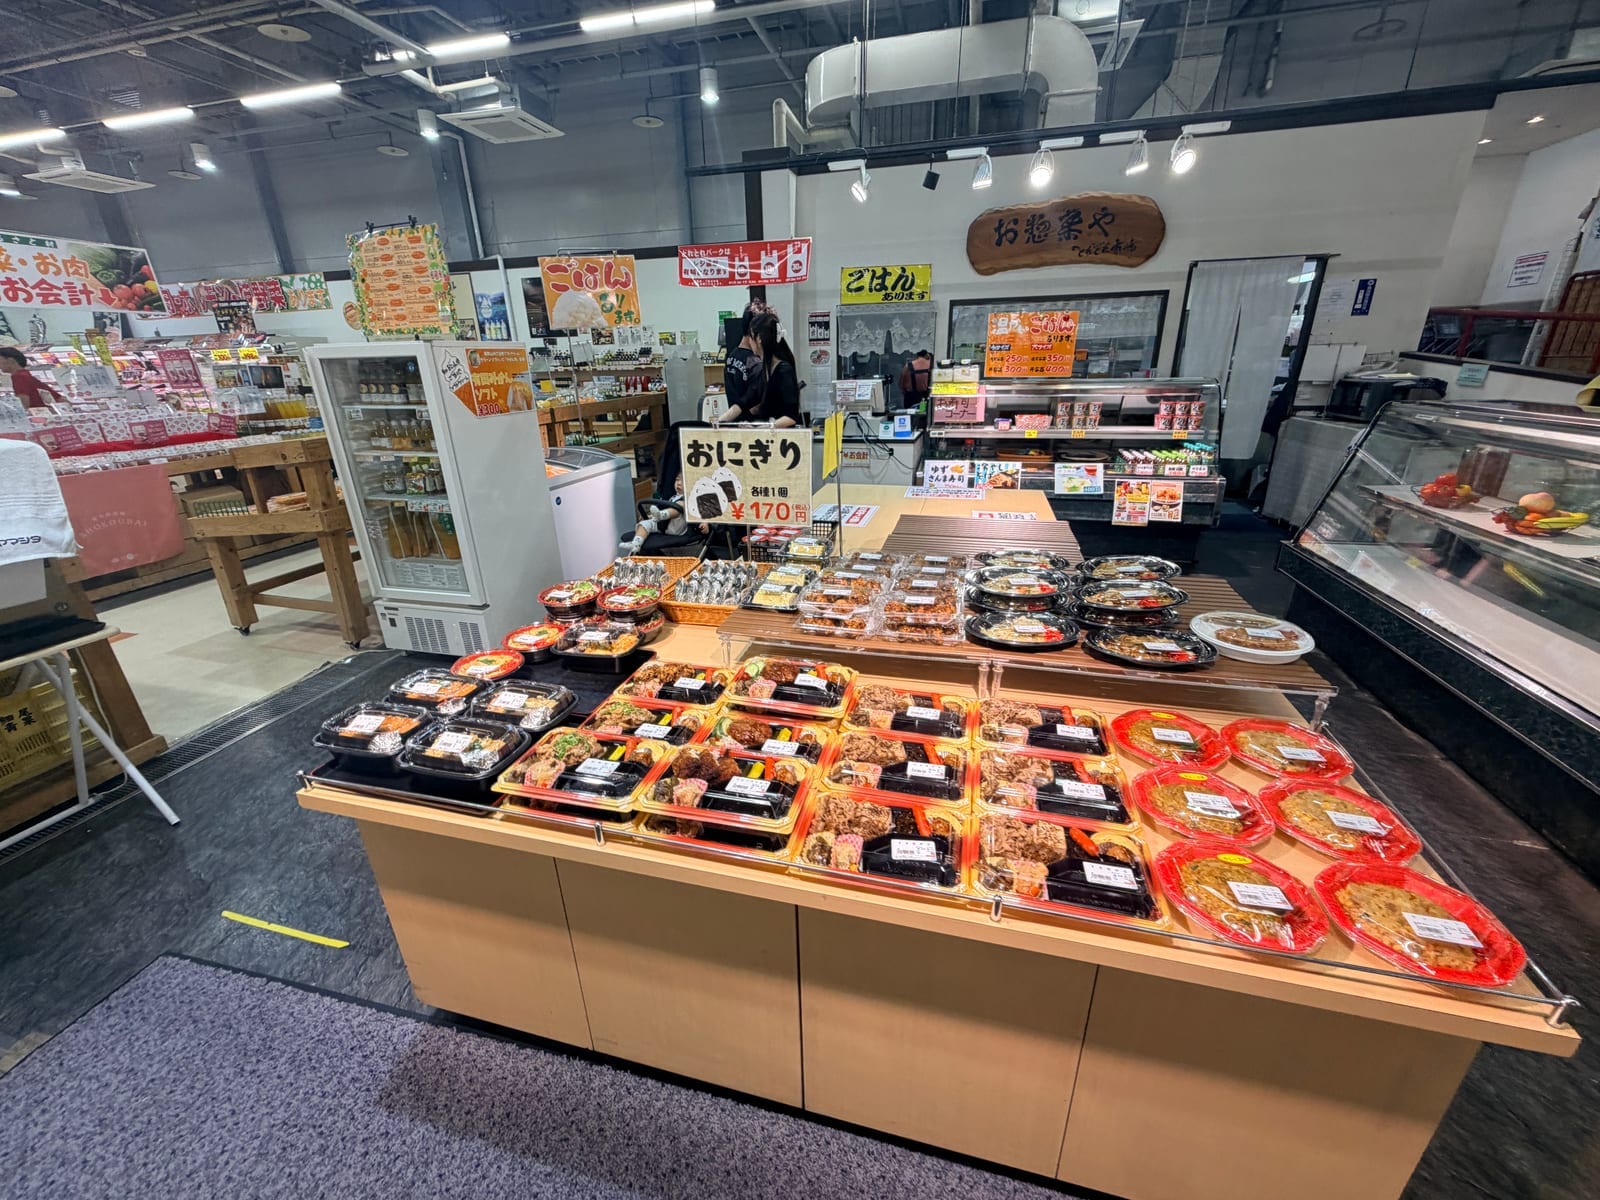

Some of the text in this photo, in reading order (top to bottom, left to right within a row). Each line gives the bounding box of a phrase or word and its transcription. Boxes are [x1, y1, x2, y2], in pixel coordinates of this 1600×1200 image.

[545, 260, 633, 292] ごはん
[846, 267, 916, 293] ごはん
[0, 277, 95, 306] お会計
[882, 291, 928, 301] あります
[475, 388, 498, 401] ソフト
[945, 409, 977, 419] コーナー
[687, 439, 801, 471] おにぎり
[931, 464, 949, 475] ゆず
[751, 486, 789, 498] 各種1個
